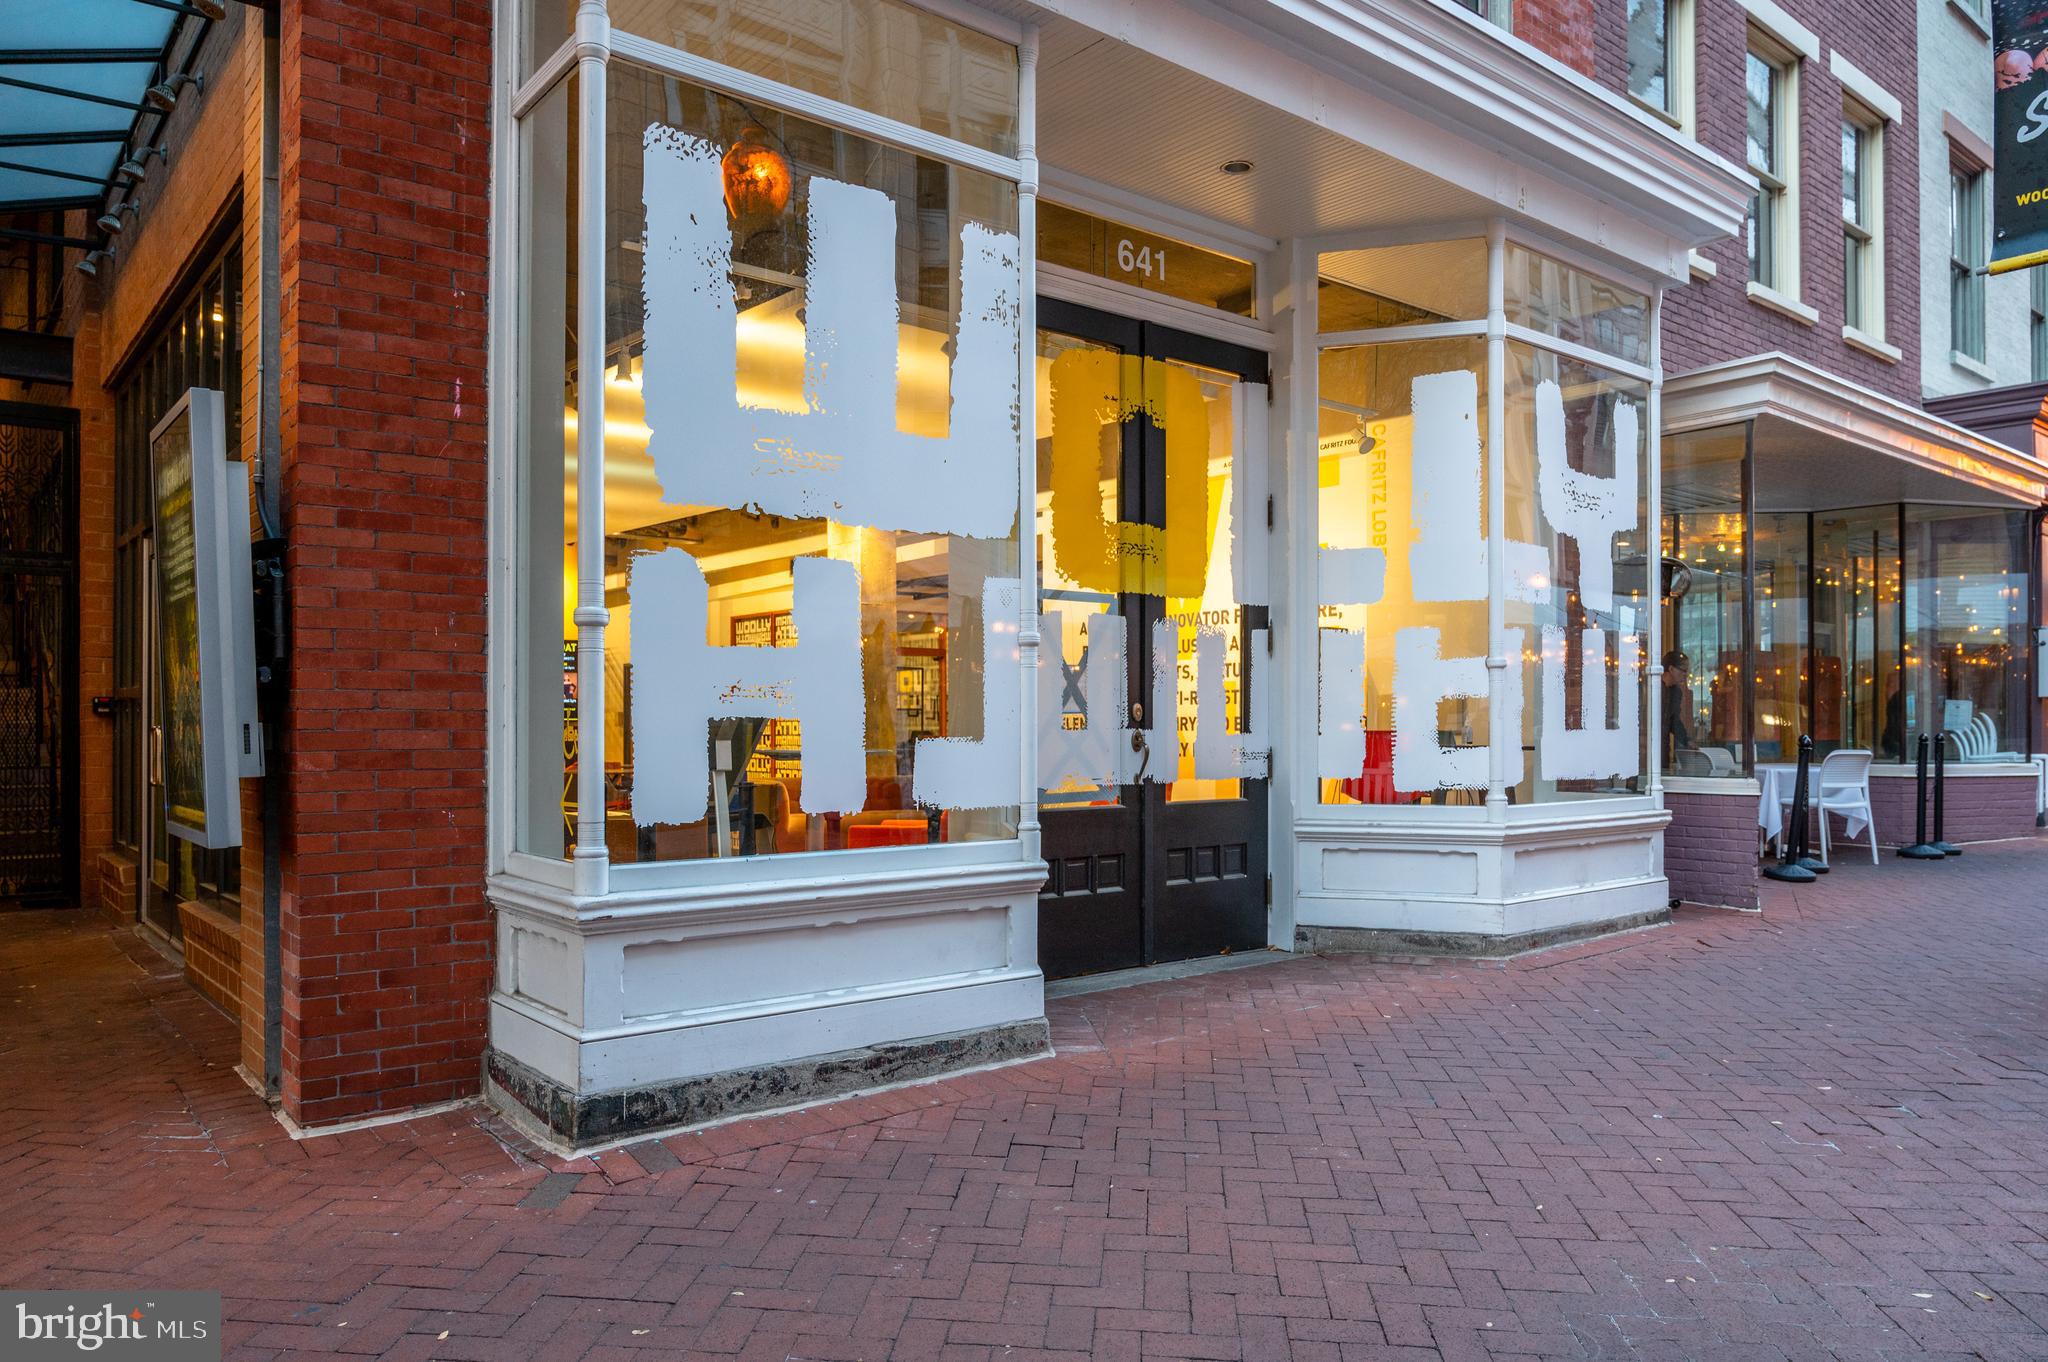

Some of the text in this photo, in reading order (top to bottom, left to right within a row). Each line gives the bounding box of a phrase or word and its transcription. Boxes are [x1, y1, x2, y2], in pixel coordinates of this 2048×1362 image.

[1117, 239, 1165, 281] 641
[1319, 440, 1343, 450] CAFRITZ
[1372, 423, 1387, 505] CAFRITZ
